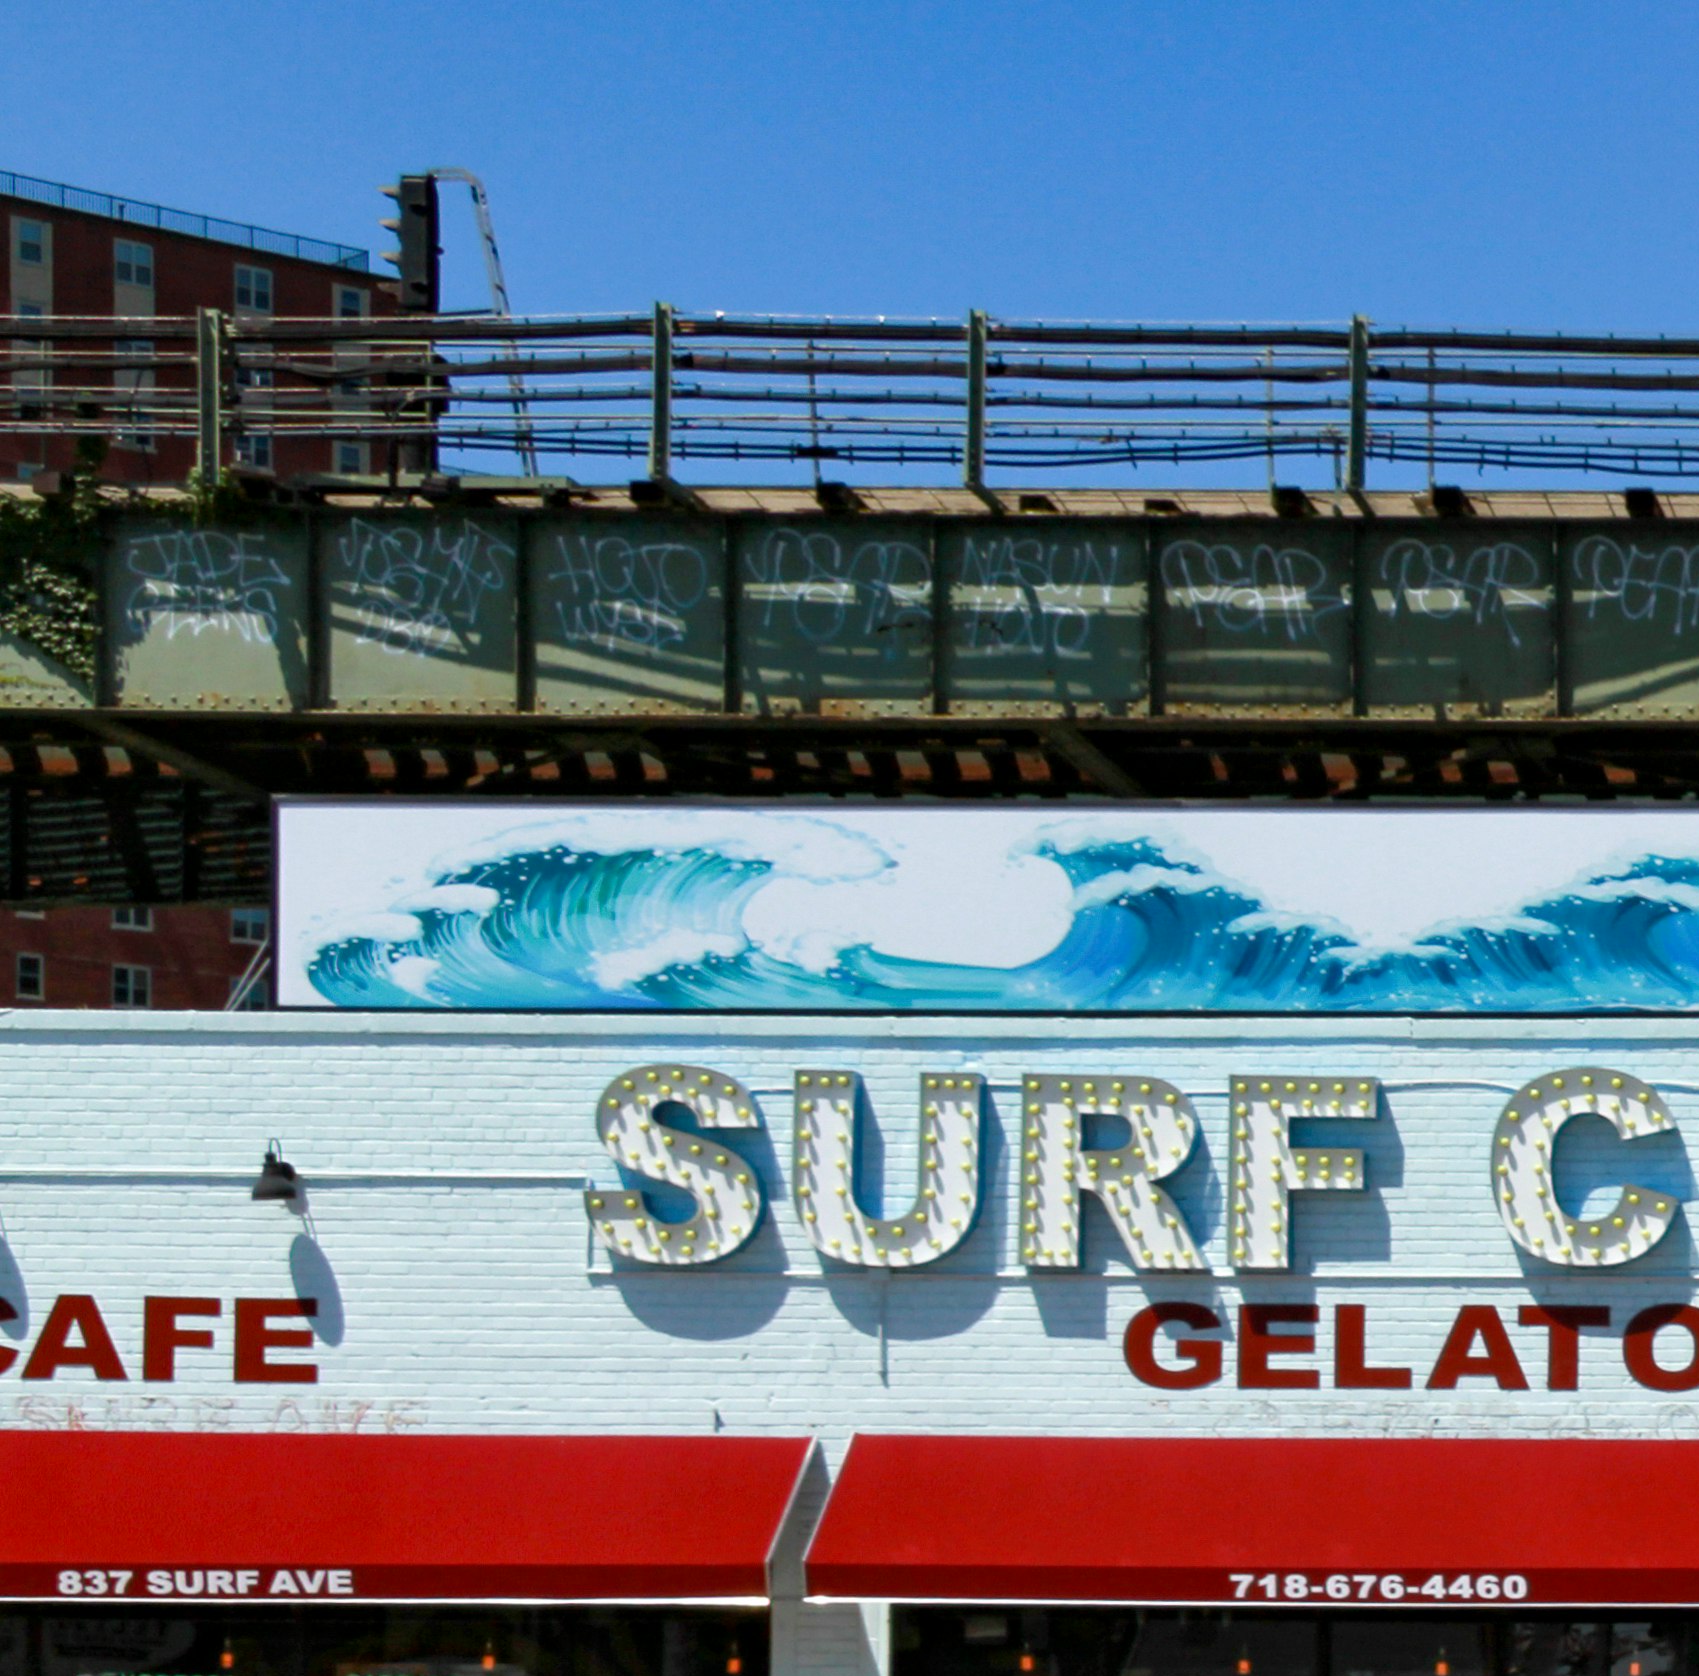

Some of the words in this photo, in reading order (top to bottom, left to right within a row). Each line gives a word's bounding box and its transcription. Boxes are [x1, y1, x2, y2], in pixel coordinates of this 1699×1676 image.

[585, 1064, 1379, 1271] SURF
[0, 1294, 319, 1384] AFE
[58, 1570, 133, 1595] 837
[146, 1570, 260, 1595] SURF
[269, 1570, 353, 1595] AVE
[1230, 1574, 1527, 1599] 718-676-4460
